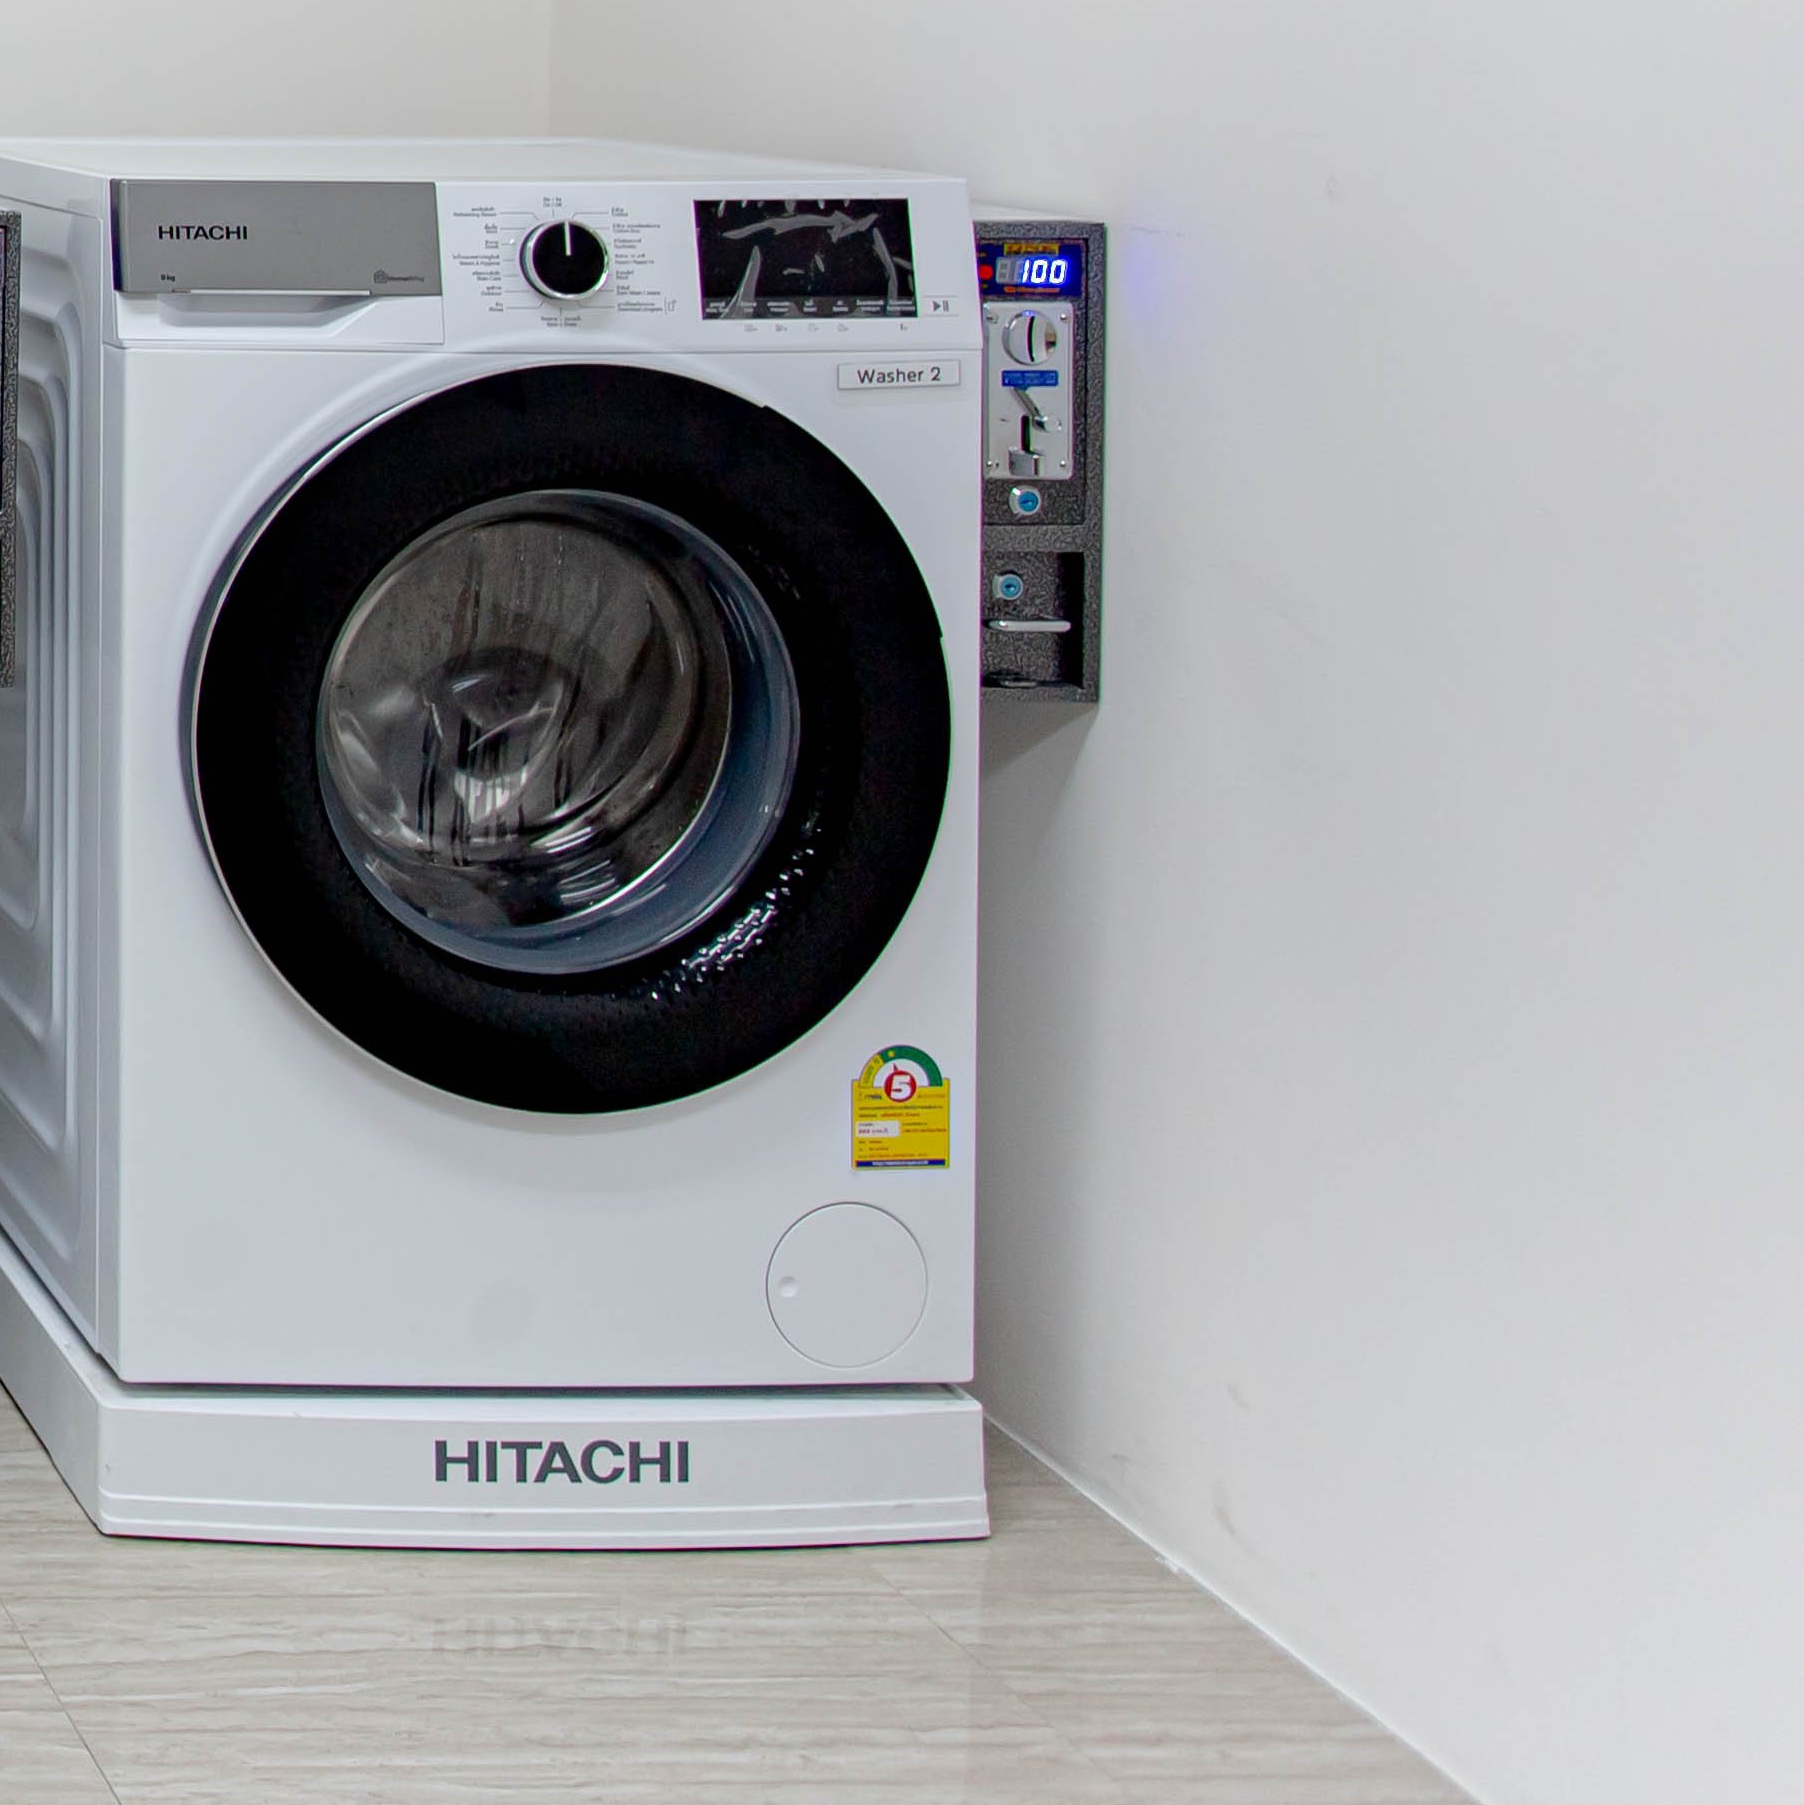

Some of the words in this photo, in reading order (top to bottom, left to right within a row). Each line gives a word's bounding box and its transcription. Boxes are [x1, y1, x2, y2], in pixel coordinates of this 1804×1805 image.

[158, 225, 248, 241] HITACHI
[1022, 259, 1067, 284] 100
[857, 367, 924, 384] Washer
[931, 366, 942, 382] 2
[890, 1074, 911, 1100] 5
[434, 1439, 690, 1485] HITACHI
